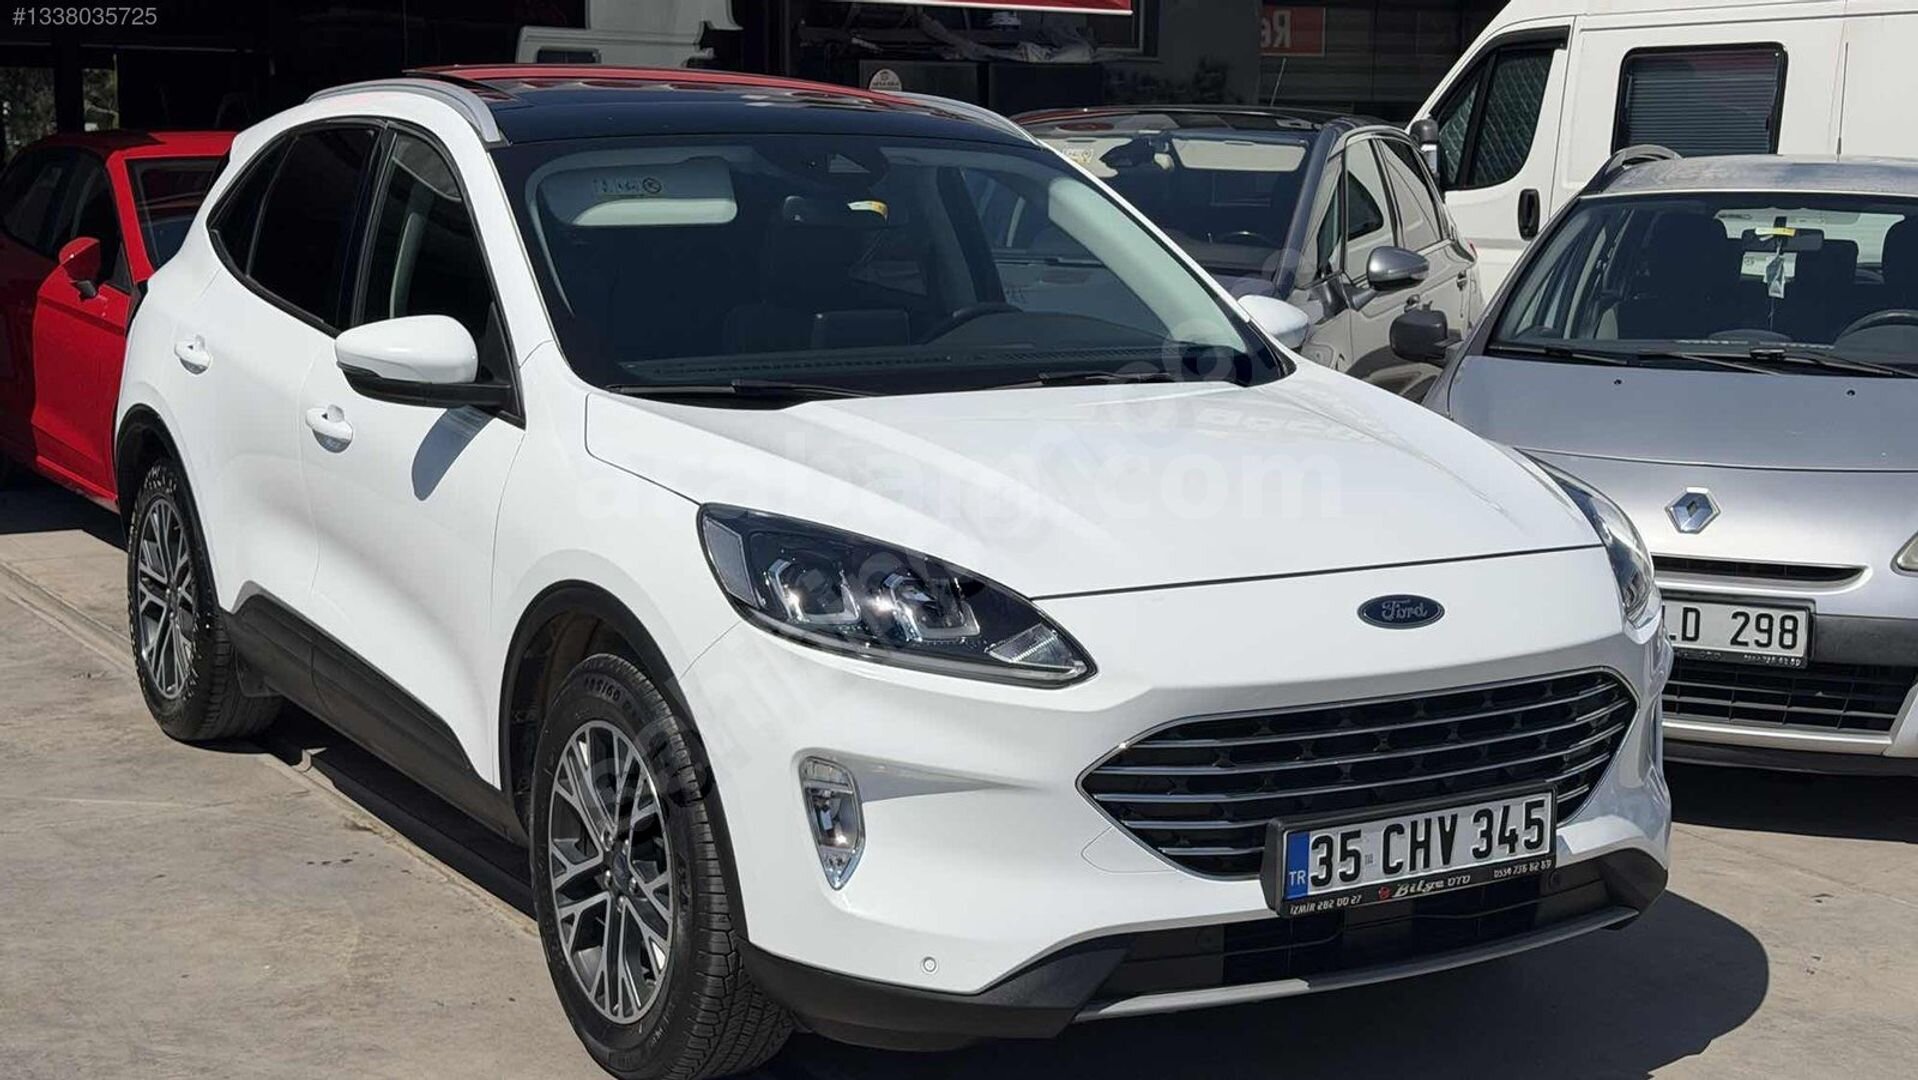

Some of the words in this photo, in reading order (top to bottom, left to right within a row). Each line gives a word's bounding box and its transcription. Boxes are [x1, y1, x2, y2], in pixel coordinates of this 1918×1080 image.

[1382, 599, 1428, 621] Ford
[1730, 611, 1799, 650] 298
[1288, 870, 1306, 886] TR
[1310, 829, 1362, 887] 35
[1382, 813, 1458, 875] CHV
[1472, 800, 1545, 859] 345
